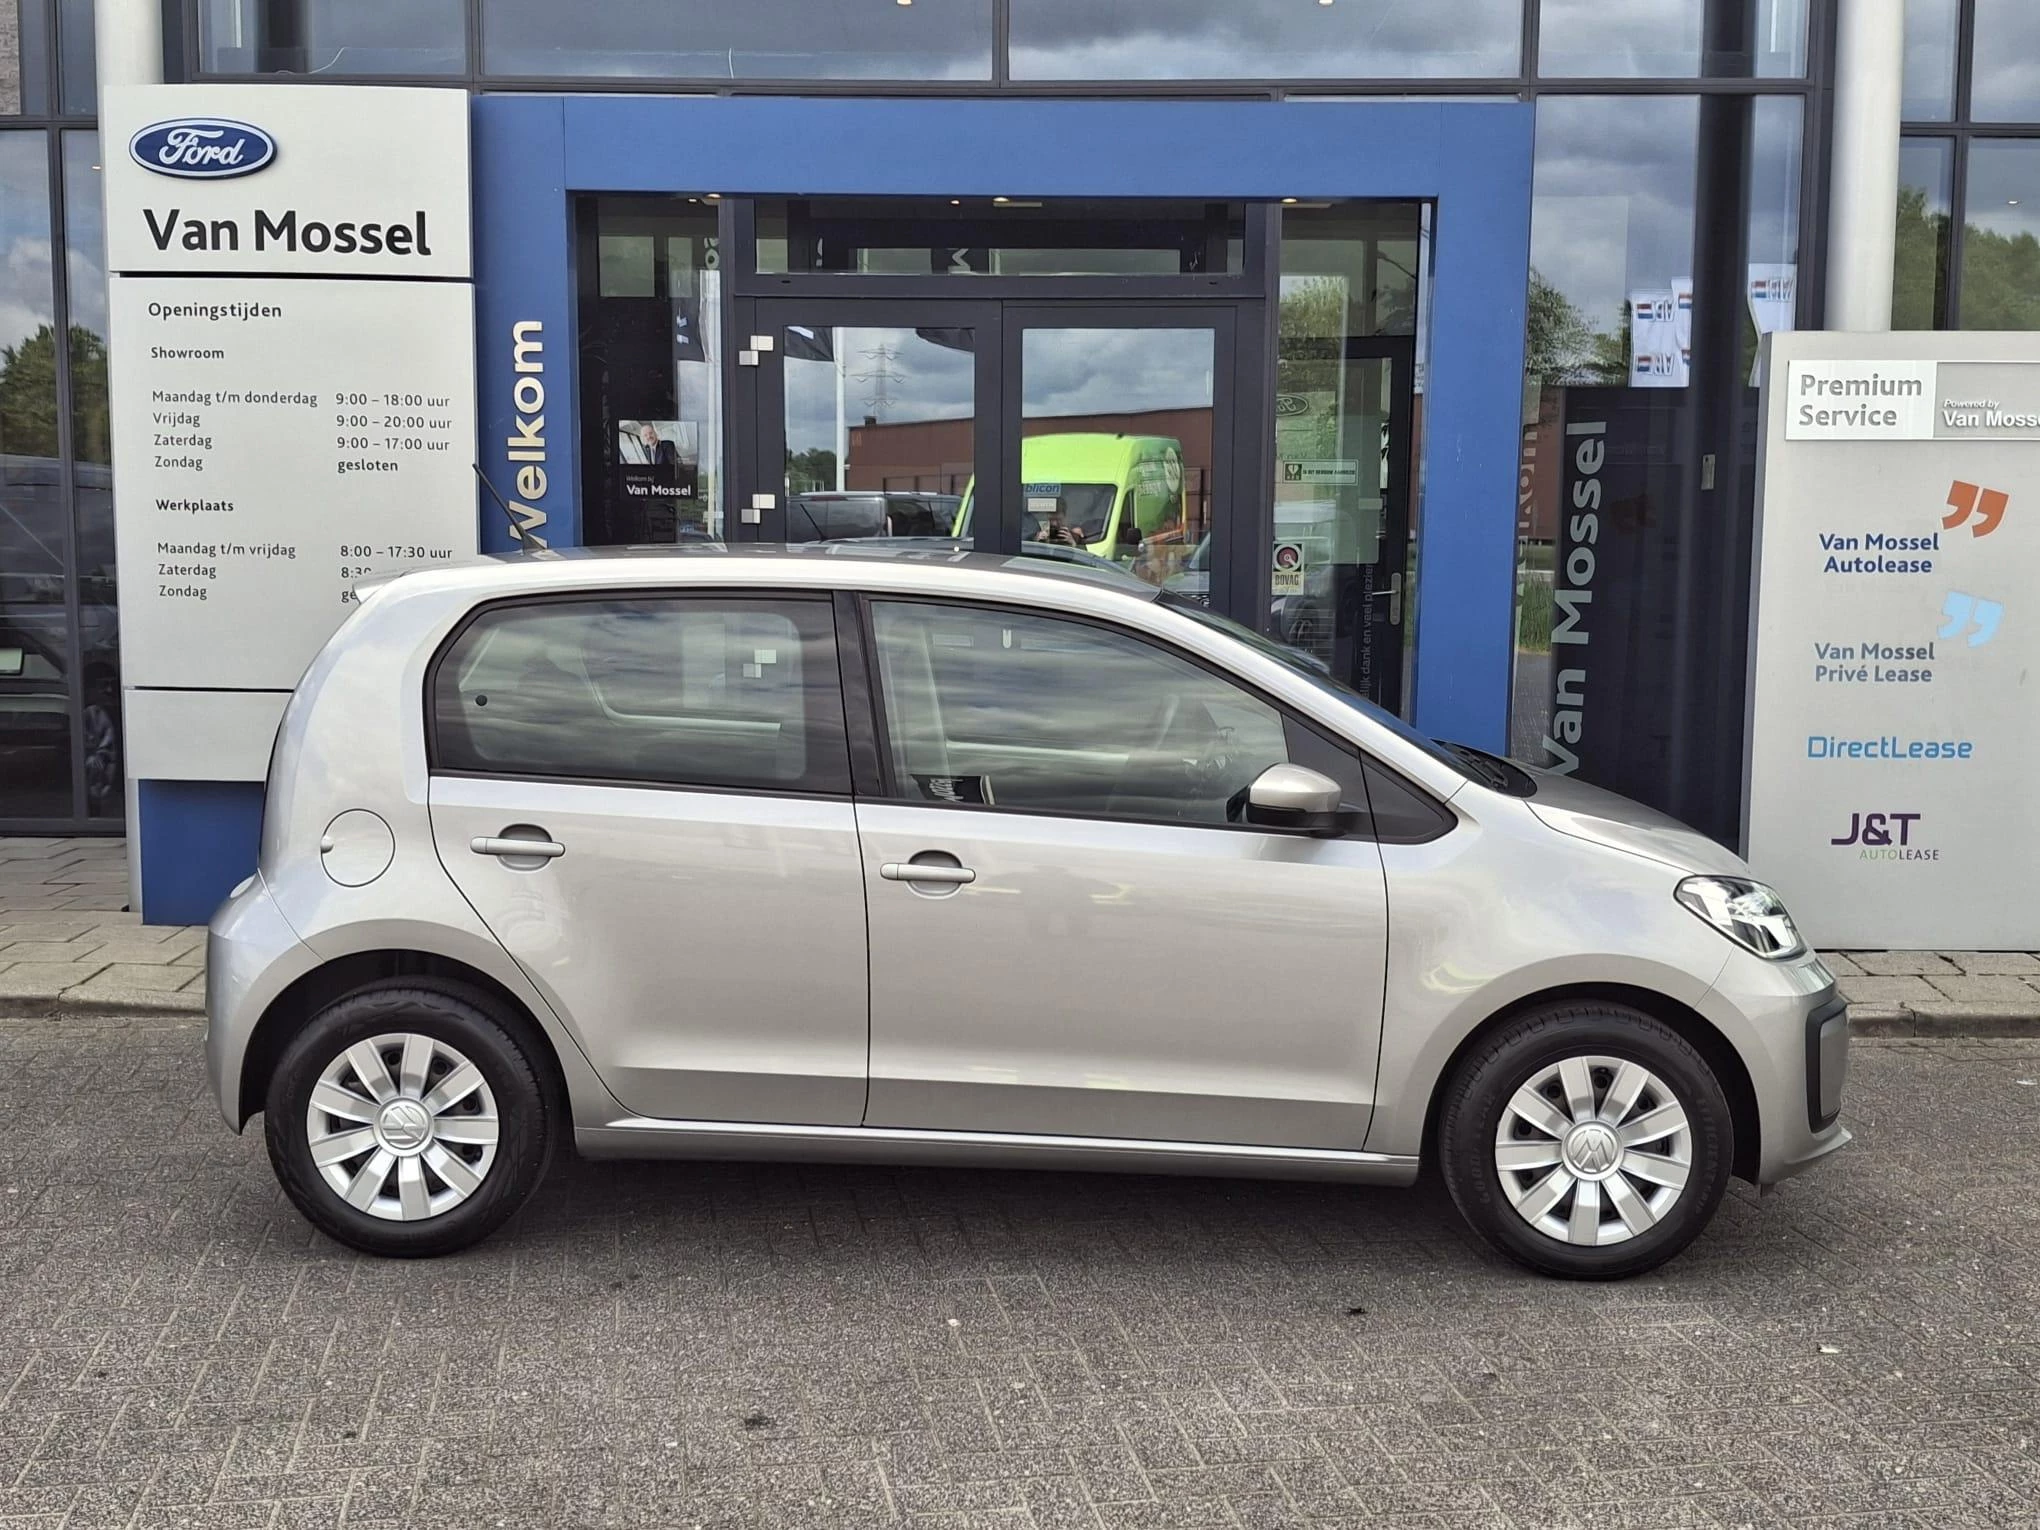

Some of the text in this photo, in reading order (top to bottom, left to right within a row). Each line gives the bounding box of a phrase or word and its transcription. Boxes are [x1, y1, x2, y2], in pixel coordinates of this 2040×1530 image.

[158, 127, 246, 165] Ford
[142, 208, 432, 256] Van Mossel
[148, 301, 282, 322] Openingstijden
[151, 346, 225, 359] Showroom
[1800, 373, 1922, 397] Premium
[152, 389, 212, 405] Maandag
[215, 390, 241, 404] t/m
[244, 390, 319, 408] donderdag
[335, 392, 368, 407] 9:00
[383, 393, 423, 407] 18:00
[427, 397, 450, 407] uur
[1943, 399, 2000, 410] Powered by
[152, 411, 201, 428] Vrijdag
[336, 414, 368, 428] 9:00
[383, 415, 425, 429] 20:00
[429, 419, 452, 429] uur
[1798, 404, 1897, 427] Service
[1943, 410, 2040, 428] Van Moss
[154, 433, 213, 450] Zaterdag
[336, 436, 369, 450] 9:00
[384, 437, 423, 451] 17:00
[426, 441, 450, 451] uur
[506, 319, 548, 550] Welkom
[154, 455, 399, 474] Zondag gesloten
[625, 484, 692, 497] Van Mossel
[155, 498, 234, 515] Werkplaats
[157, 541, 217, 558] Maandag
[220, 542, 245, 556] t/m
[249, 543, 297, 561] vrijdag
[340, 545, 372, 558] 8:00
[387, 545, 426, 559] 17:30
[429, 549, 453, 559] uur
[1818, 532, 1940, 551] Van Mossel
[158, 563, 217, 580] Zaterdag
[1823, 555, 1933, 574] Autolease
[159, 584, 208, 602] Zondag
[1541, 421, 1608, 776] Van Mossel
[1814, 641, 1935, 661] Van Mossel
[1815, 664, 1933, 683] Privé Lease
[1807, 735, 1973, 759] DirectLease
[1830, 812, 1922, 846] J&T
[1859, 848, 1940, 861] AUTOLEASE
